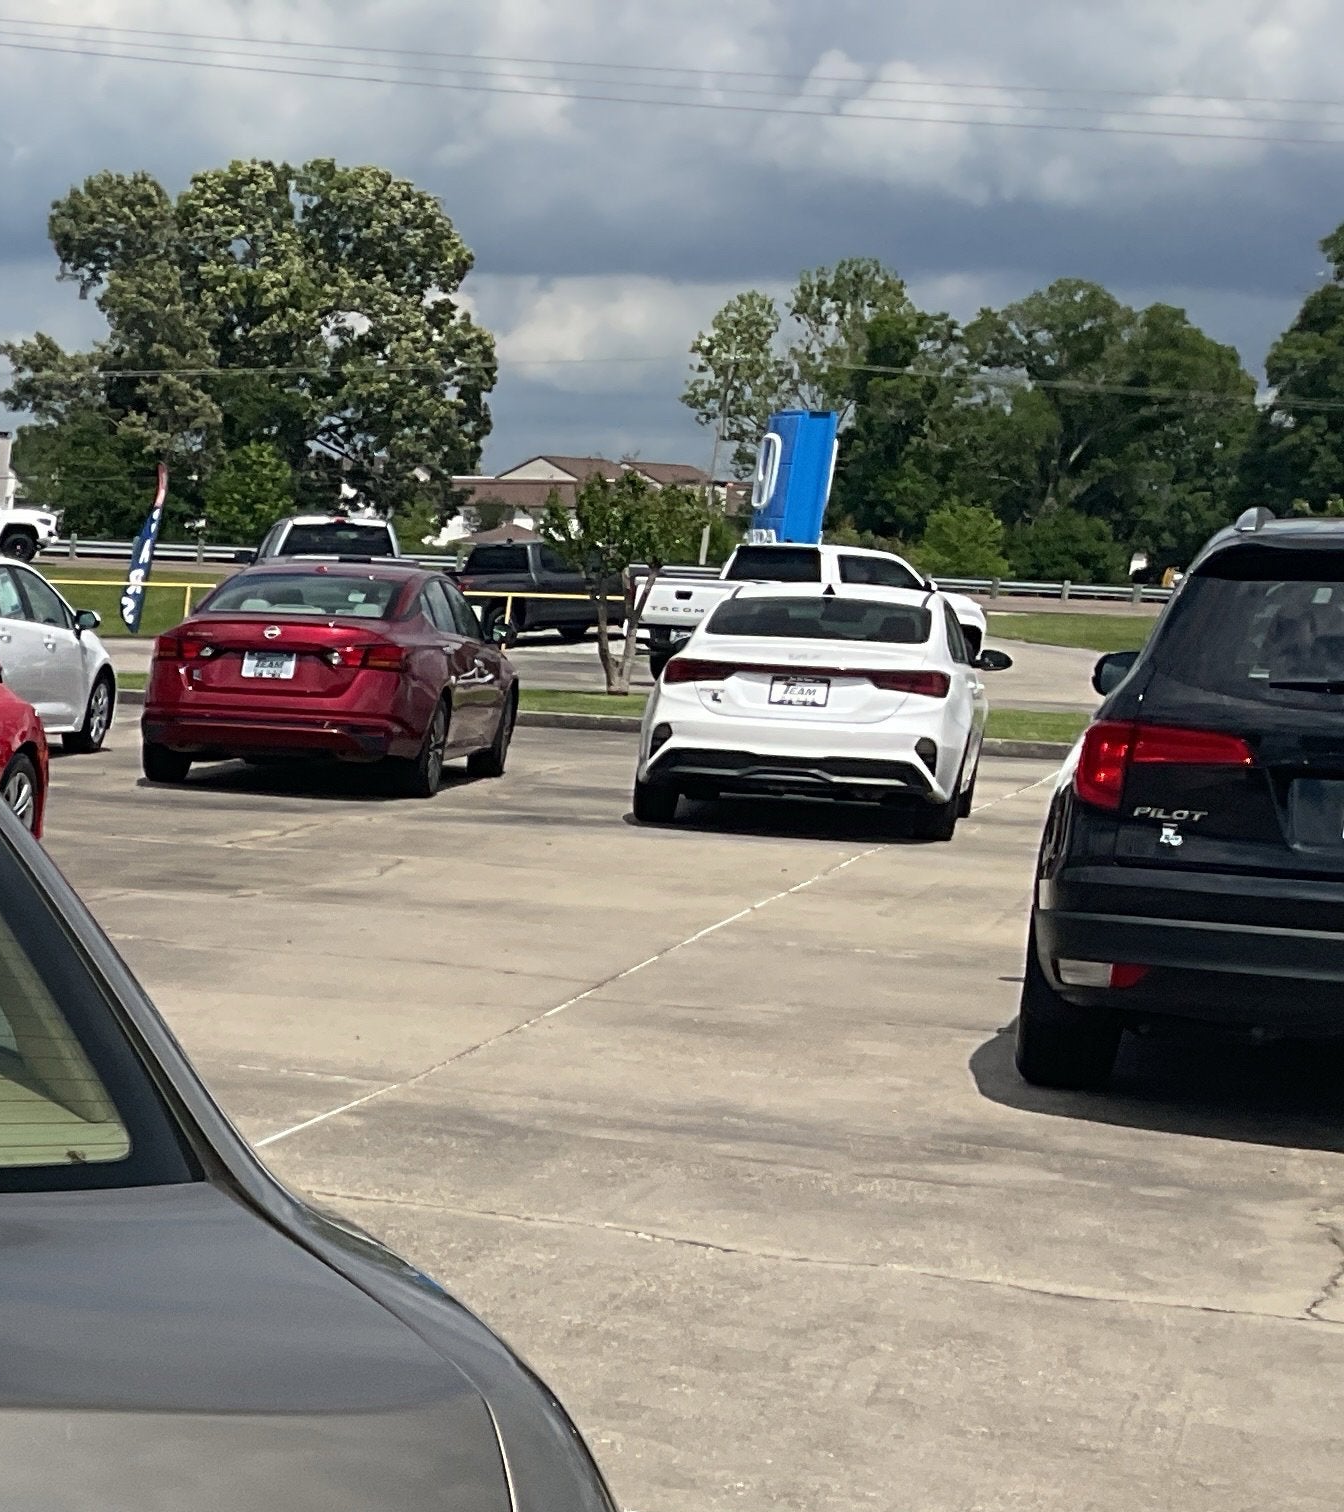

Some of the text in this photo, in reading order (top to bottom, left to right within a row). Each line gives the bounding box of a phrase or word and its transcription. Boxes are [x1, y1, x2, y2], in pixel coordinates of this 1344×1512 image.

[650, 605, 705, 613] TACOM
[783, 681, 817, 696] TEAM
[1133, 806, 1209, 821] PILOT
